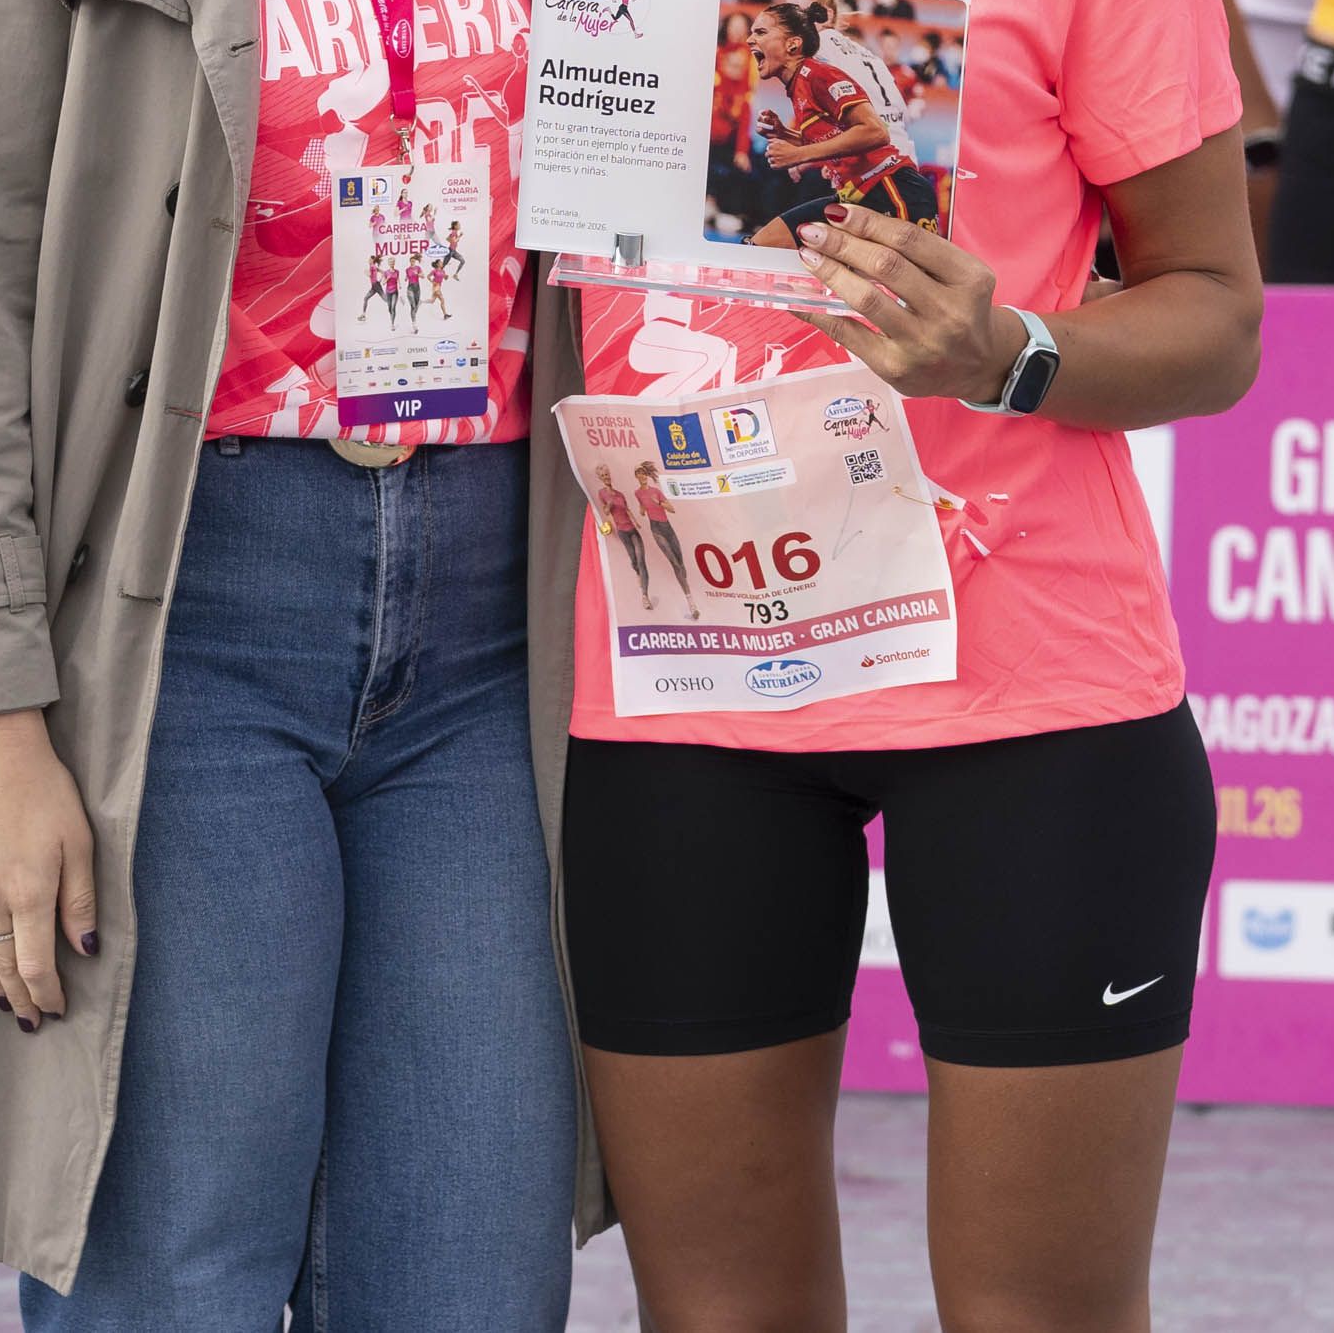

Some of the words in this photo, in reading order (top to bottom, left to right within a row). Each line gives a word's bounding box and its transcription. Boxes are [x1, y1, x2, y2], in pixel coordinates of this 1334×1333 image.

[557, 11, 568, 22] de
[569, 13, 577, 23] la
[574, 13, 617, 37] Mujer
[540, 59, 660, 89] Almudena
[539, 84, 656, 116] Rodríguez
[537, 119, 553, 130] Por
[555, 122, 565, 131] tu
[567, 123, 588, 133] gran
[590, 125, 641, 138] trayectoria
[642, 129, 687, 143] deportiva
[535, 135, 540, 144] y
[543, 135, 559, 145] por
[561, 136, 576, 146] ser
[577, 138, 589, 147] un
[591, 139, 629, 151] ejemplo
[630, 143, 637, 153] y
[638, 143, 670, 155] fuente
[671, 147, 684, 157] de
[535, 147, 585, 161] inspiración
[586, 152, 599, 161] en
[600, 152, 609, 162] el
[610, 154, 664, 169] balonmano
[665, 160, 687, 172] para
[533, 162, 572, 173] mujeres
[573, 165, 580, 175] y
[441, 186, 479, 195] CANARIA
[447, 178, 471, 186] GRAN
[531, 205, 549, 215] Gran
[378, 223, 428, 234] CARRERA
[531, 216, 539, 225] 15
[540, 216, 550, 226] de
[551, 218, 575, 228] marzo
[576, 220, 586, 229] de
[375, 240, 430, 256] MUJER
[394, 399, 422, 417] VIP
[828, 404, 863, 416] ASTURIANA
[579, 416, 595, 428] TU
[823, 417, 858, 431] Carrera
[586, 429, 641, 449] SUMA
[847, 426, 871, 440] Mujer
[694, 531, 821, 591] 016
[771, 590, 782, 598] DE
[743, 599, 789, 624] 793
[627, 632, 697, 651] CARRERA
[700, 632, 719, 650] DE
[723, 633, 741, 651] LA
[743, 632, 796, 652] MUJER
[810, 613, 860, 641] GRAN
[862, 598, 940, 628] CANARIA
[876, 646, 931, 666] Santander
[655, 676, 714, 693] OYSHO
[751, 670, 816, 689] ASTURIANA
